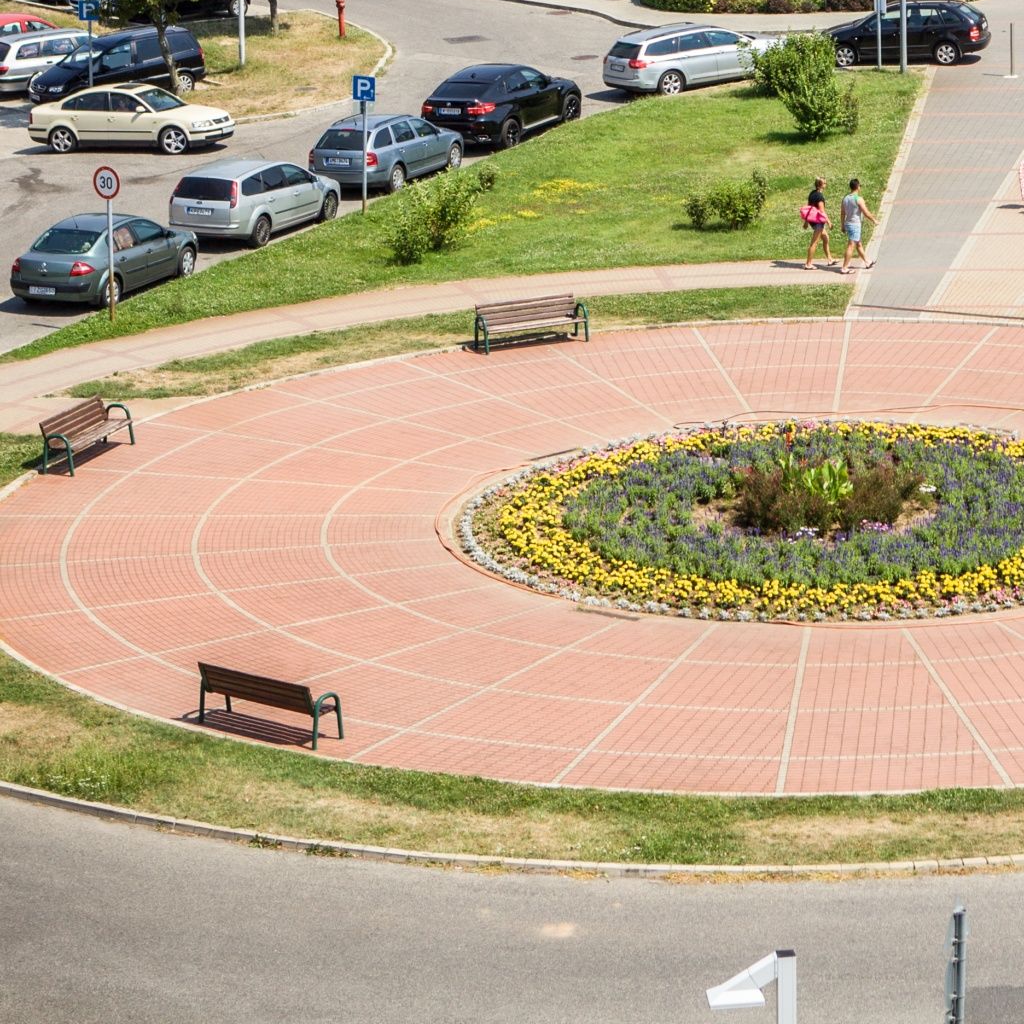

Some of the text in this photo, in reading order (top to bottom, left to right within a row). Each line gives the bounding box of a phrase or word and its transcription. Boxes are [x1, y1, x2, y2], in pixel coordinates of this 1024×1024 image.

[82, 2, 95, 18] P
[357, 78, 371, 97] P
[99, 176, 113, 189] 30
